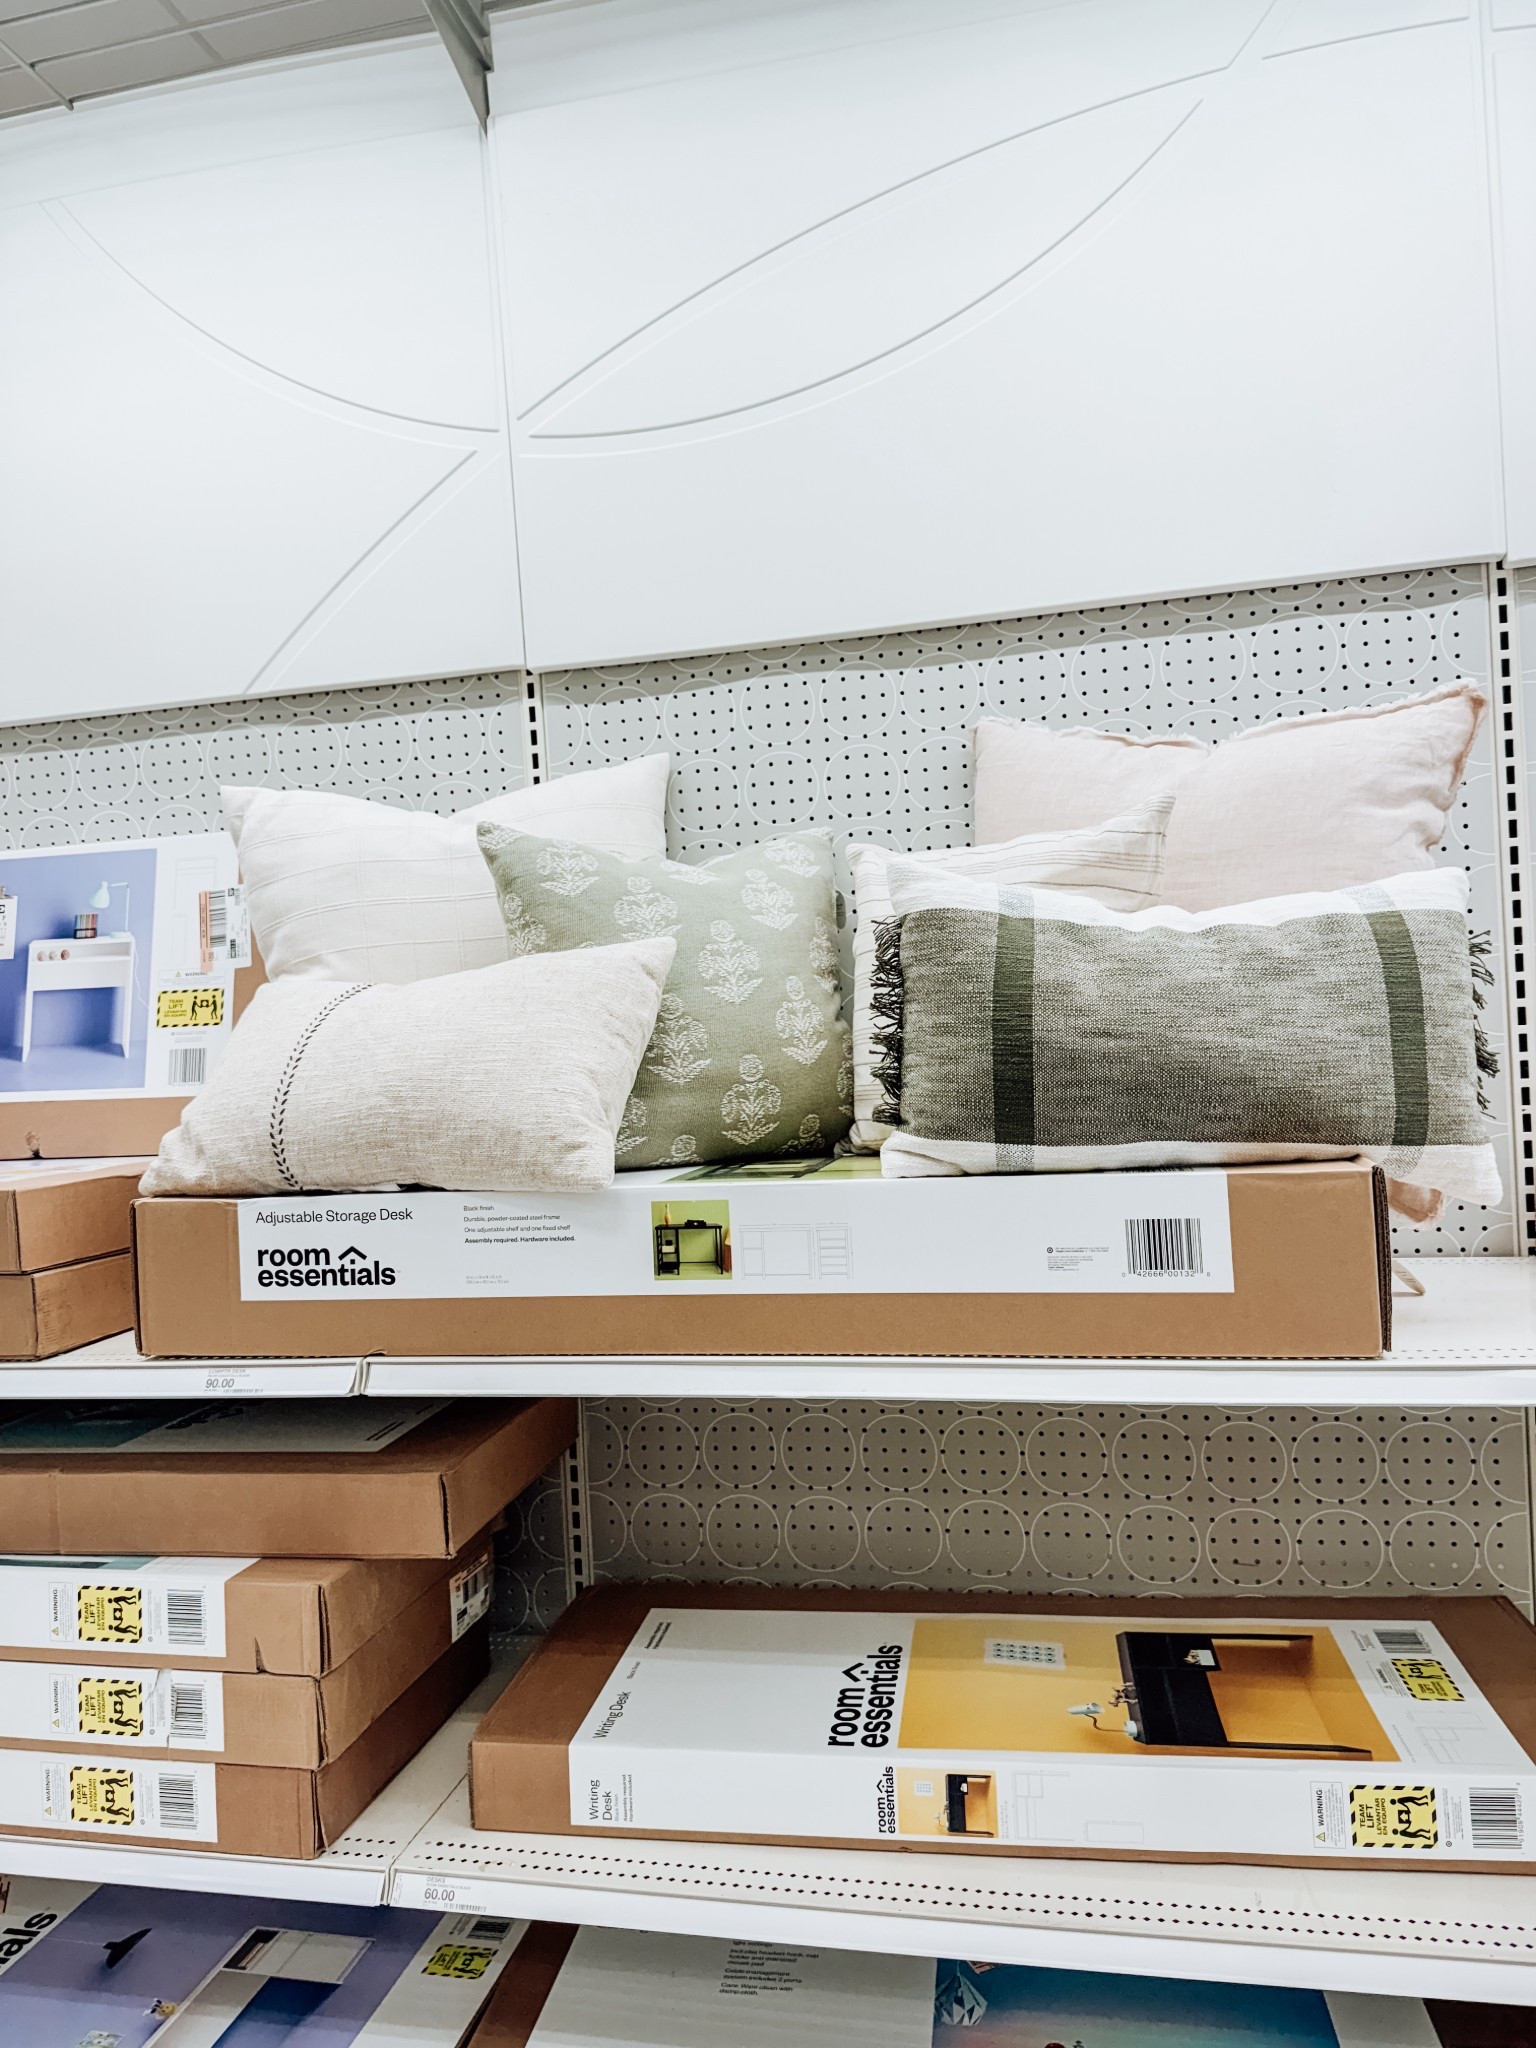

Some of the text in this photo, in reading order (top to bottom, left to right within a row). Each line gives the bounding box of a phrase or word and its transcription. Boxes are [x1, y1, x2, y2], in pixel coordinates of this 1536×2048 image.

[256, 1208, 413, 1226] Adjustable Storage Desk
[257, 1248, 330, 1266] room
[258, 1259, 396, 1287] essentials
[206, 1378, 234, 1388] 90.00
[102, 1622, 105, 1630] EN
[860, 1645, 903, 1748] essentials
[102, 1714, 106, 1723] EN
[592, 1691, 631, 1738] Writing Desk
[828, 1688, 865, 1746] room
[94, 1802, 98, 1812] EN
[589, 1779, 600, 1820] Writing
[602, 1791, 612, 1820] Desk
[882, 1766, 896, 1834] essentials
[1366, 1804, 1374, 1828] LIFT
[1382, 1826, 1388, 1836] EN
[424, 1888, 455, 1901] 60.00
